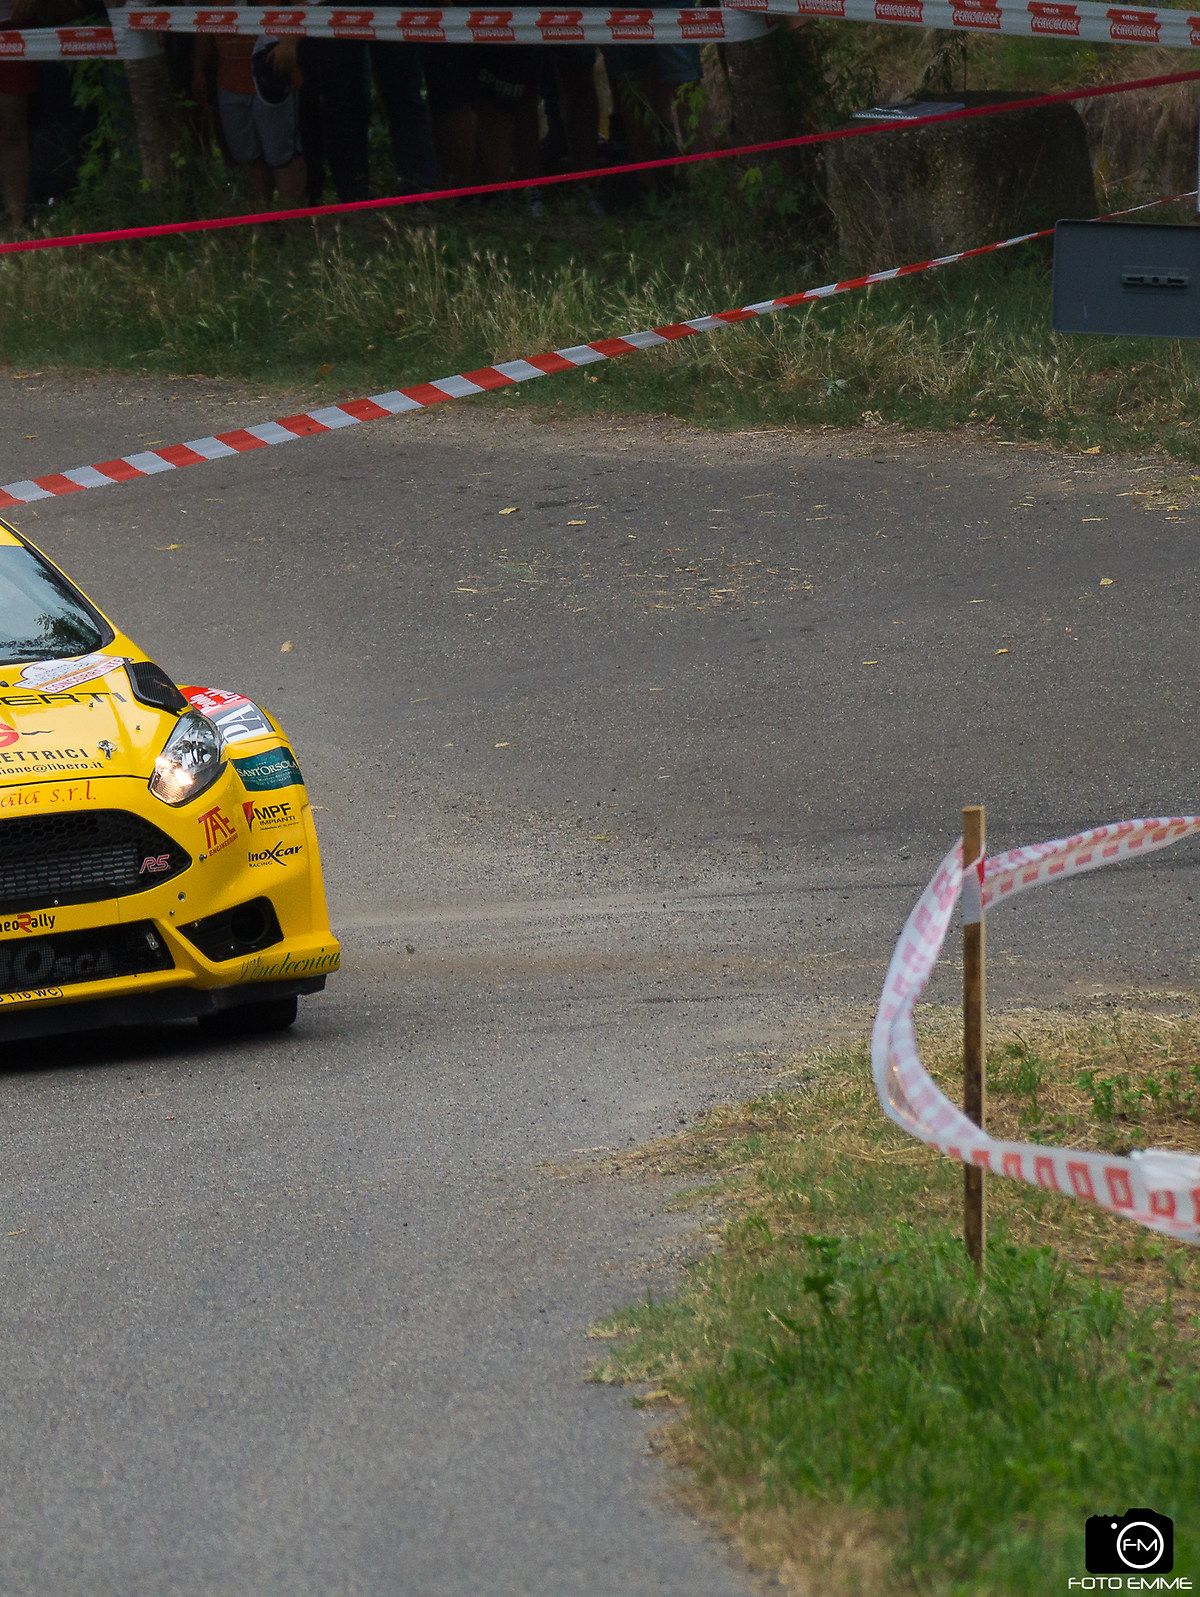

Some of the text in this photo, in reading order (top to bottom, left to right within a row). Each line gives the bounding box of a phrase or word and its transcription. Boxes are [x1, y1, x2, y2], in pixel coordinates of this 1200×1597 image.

[876, 3, 921, 19] PERICOLOSA
[953, 10, 1000, 27] PERICOLOSA
[1032, 16, 1080, 33] PERICOLOSA
[1111, 23, 1159, 39] PERICOLOSA
[45, 658, 122, 691] CONCORRENTE
[49, 780, 97, 804] s.r.l.
[254, 802, 292, 821] MPF
[198, 805, 236, 850] TAE
[259, 815, 296, 826] IMPIANTI
[34, 988, 58, 998] WC
